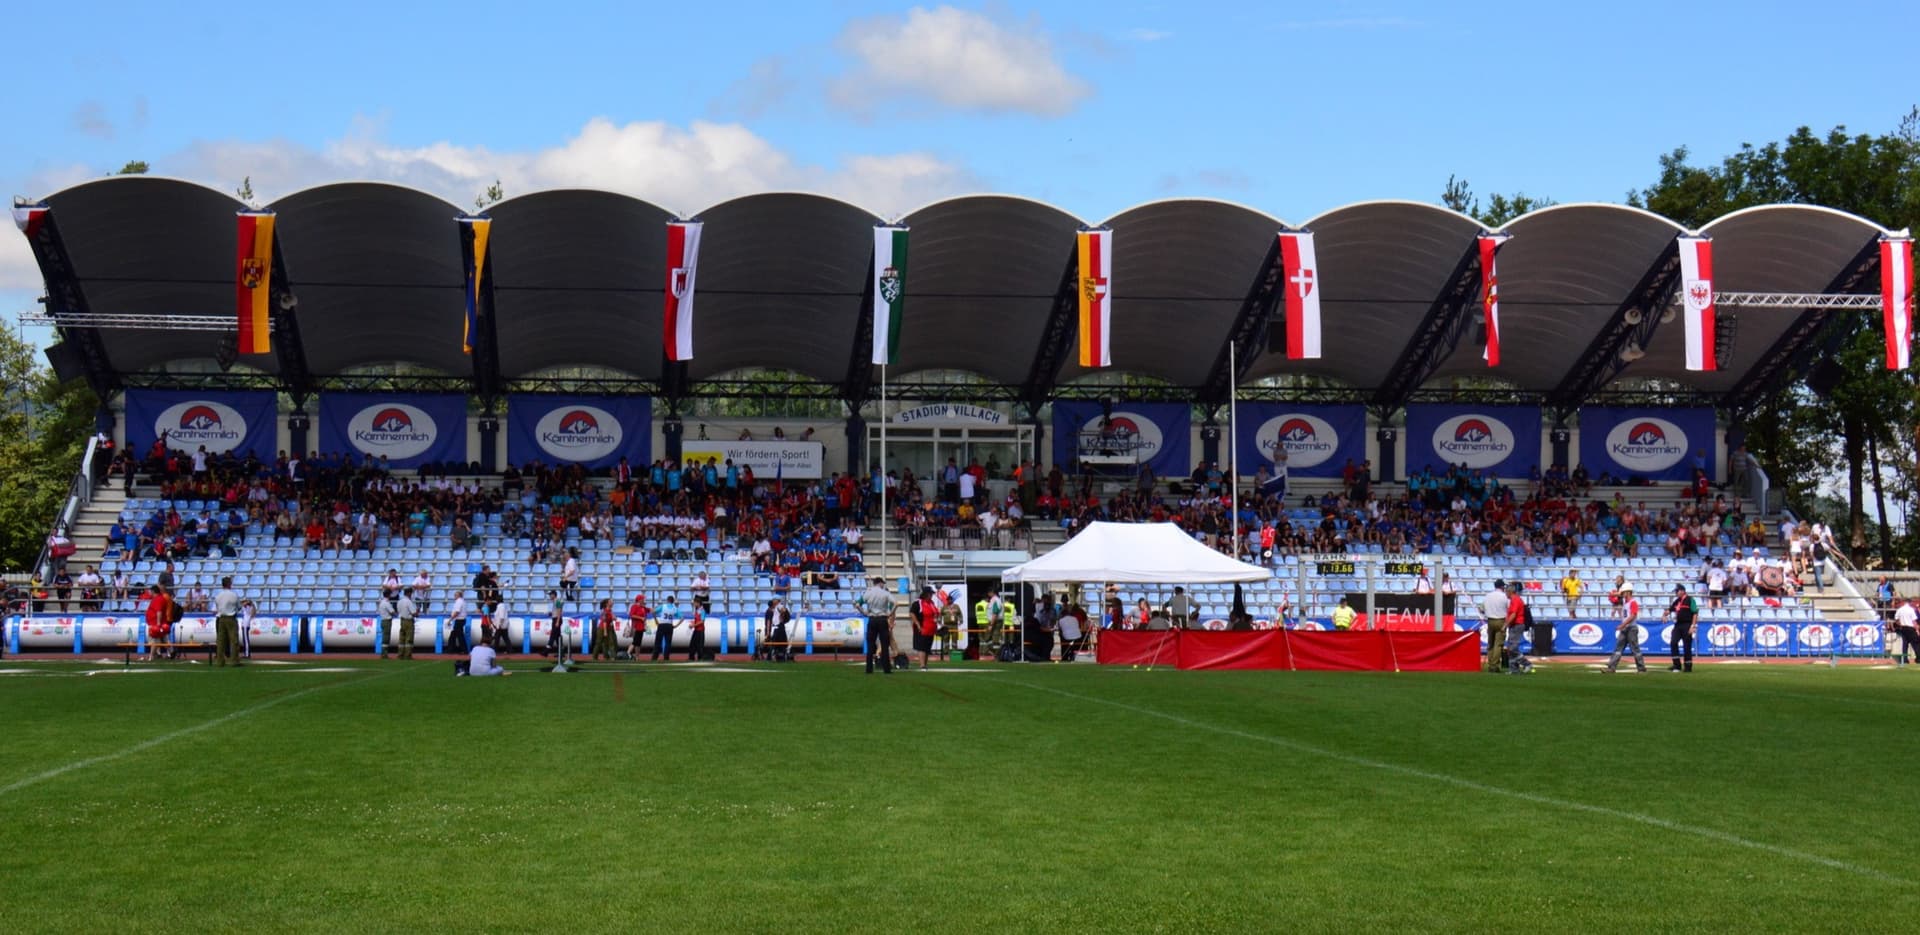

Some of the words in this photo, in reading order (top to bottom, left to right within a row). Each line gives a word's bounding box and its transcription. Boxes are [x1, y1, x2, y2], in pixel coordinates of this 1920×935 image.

[902, 405, 948, 422] STADION
[954, 405, 1000, 423] VILLACH
[728, 450, 743, 459] Wir
[745, 449, 779, 459] fördern
[782, 450, 810, 461] Sport!
[1374, 607, 1431, 624] TEAM
